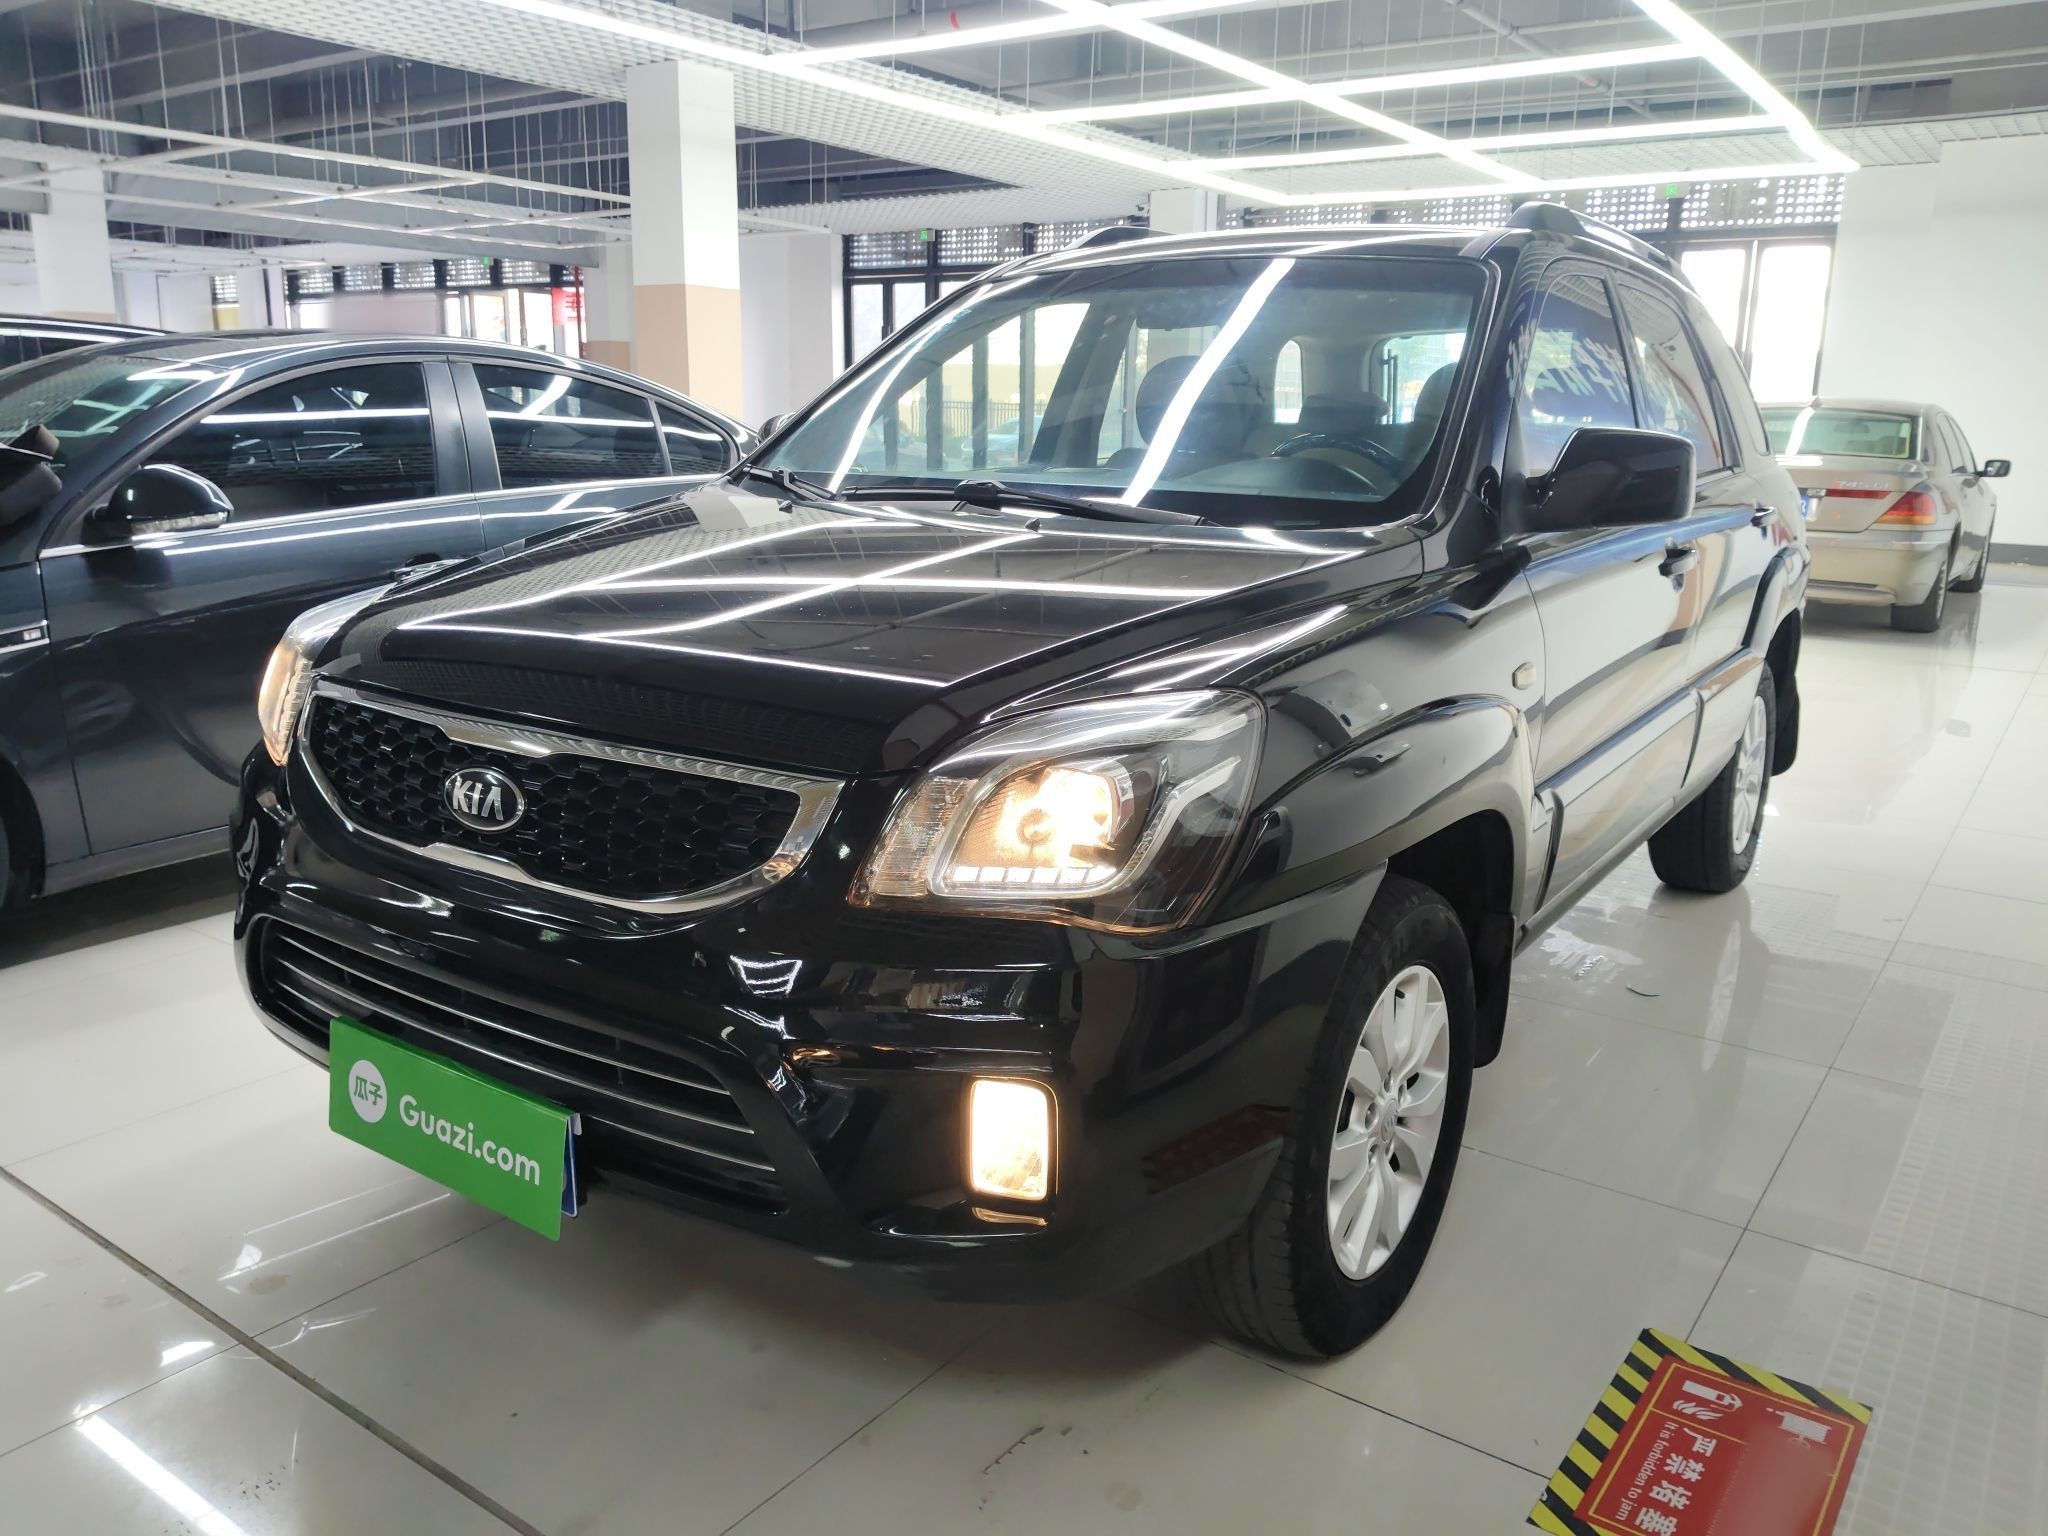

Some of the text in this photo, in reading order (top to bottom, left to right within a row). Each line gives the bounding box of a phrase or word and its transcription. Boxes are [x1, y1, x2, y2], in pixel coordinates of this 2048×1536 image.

[452, 776, 504, 821] KIA
[353, 1076, 383, 1105] 瓜子
[400, 1094, 540, 1185] Guazi.com
[1616, 1421, 1679, 1520] It is forbidden to jam
[1634, 1427, 1717, 1536] 严禁堵塞
